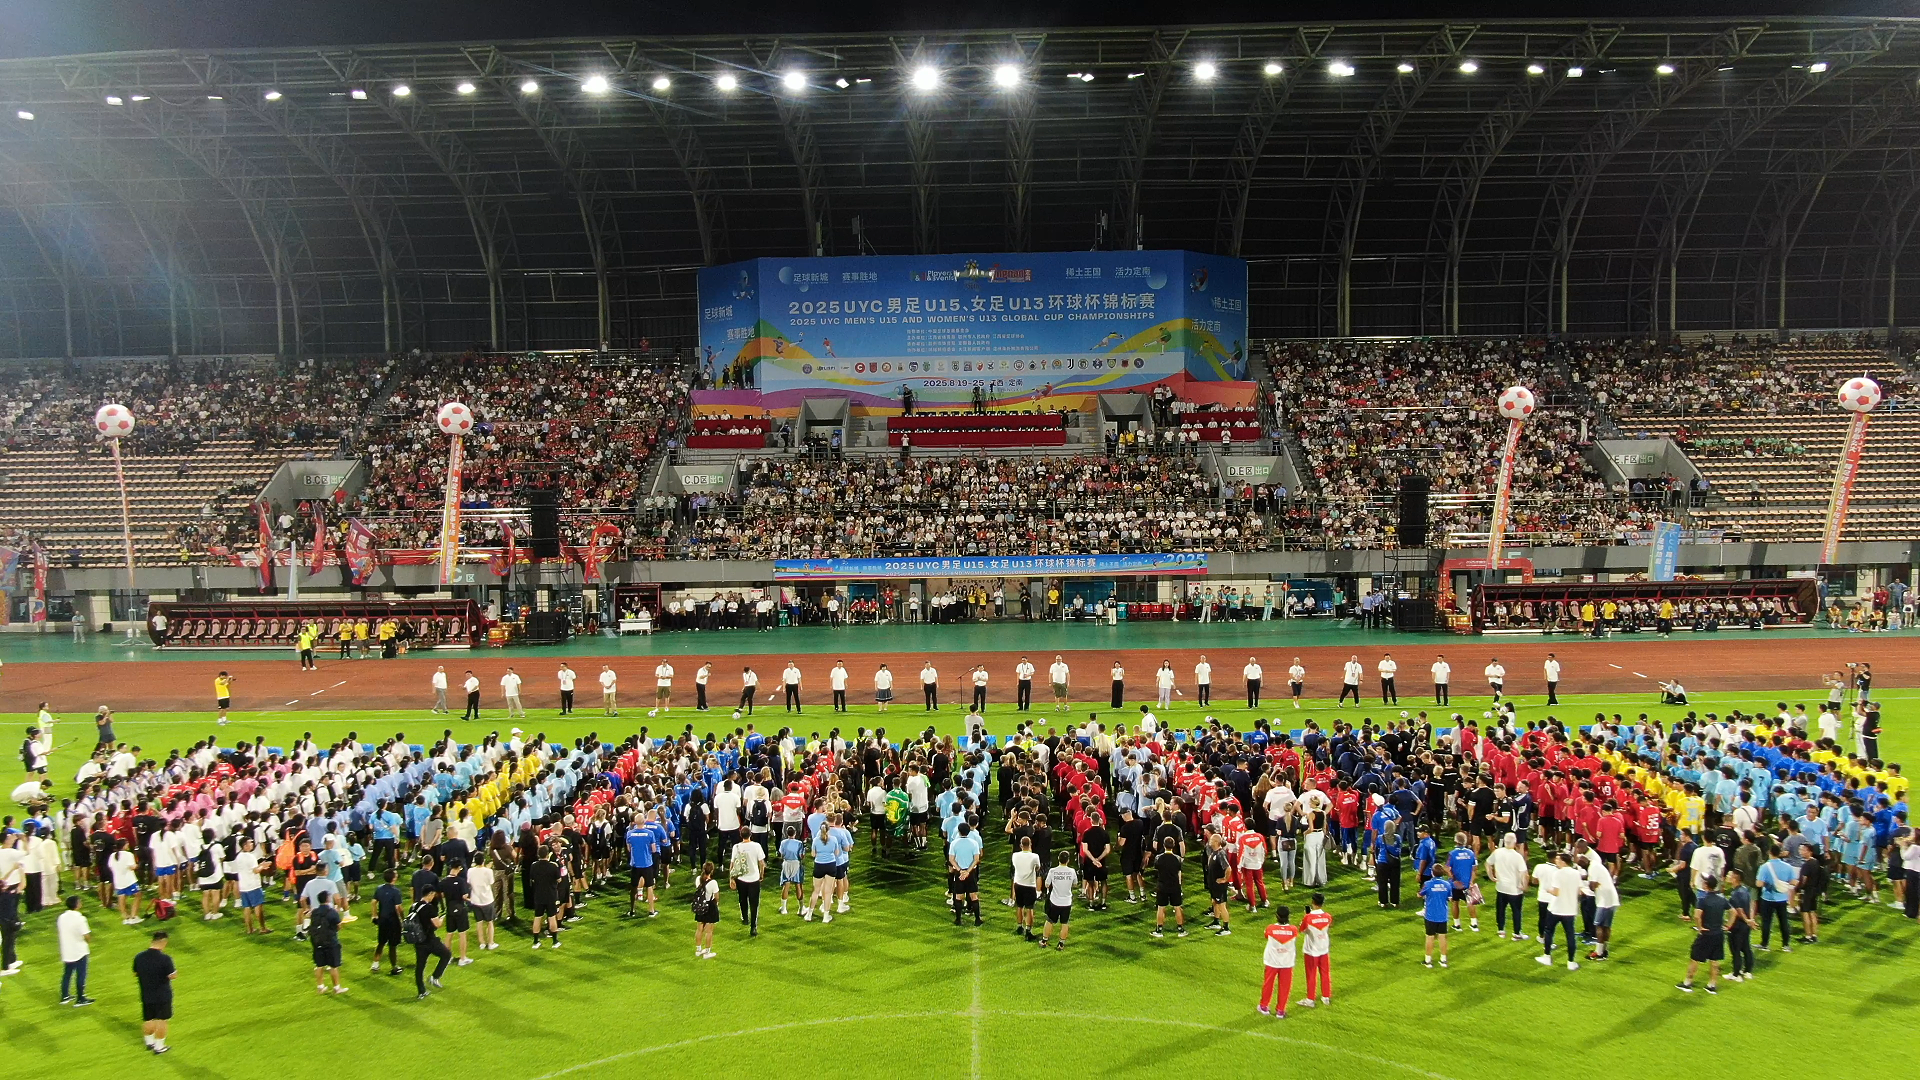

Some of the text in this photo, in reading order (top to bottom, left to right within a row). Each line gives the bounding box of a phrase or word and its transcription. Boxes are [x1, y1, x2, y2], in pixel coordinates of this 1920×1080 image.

[793, 272, 829, 282] 足球新城
[842, 272, 878, 281] 赛事胜地
[1115, 266, 1151, 276] 活力定南
[704, 305, 734, 320] 足球新城
[790, 311, 1155, 326] 2025 UYC MEN'S U15 AND WOMEN'S U13 GLOBAL CUP CHAMPIONSHIPS
[1191, 318, 1221, 332] 活力定南
[1646, 817, 1659, 830] 35
